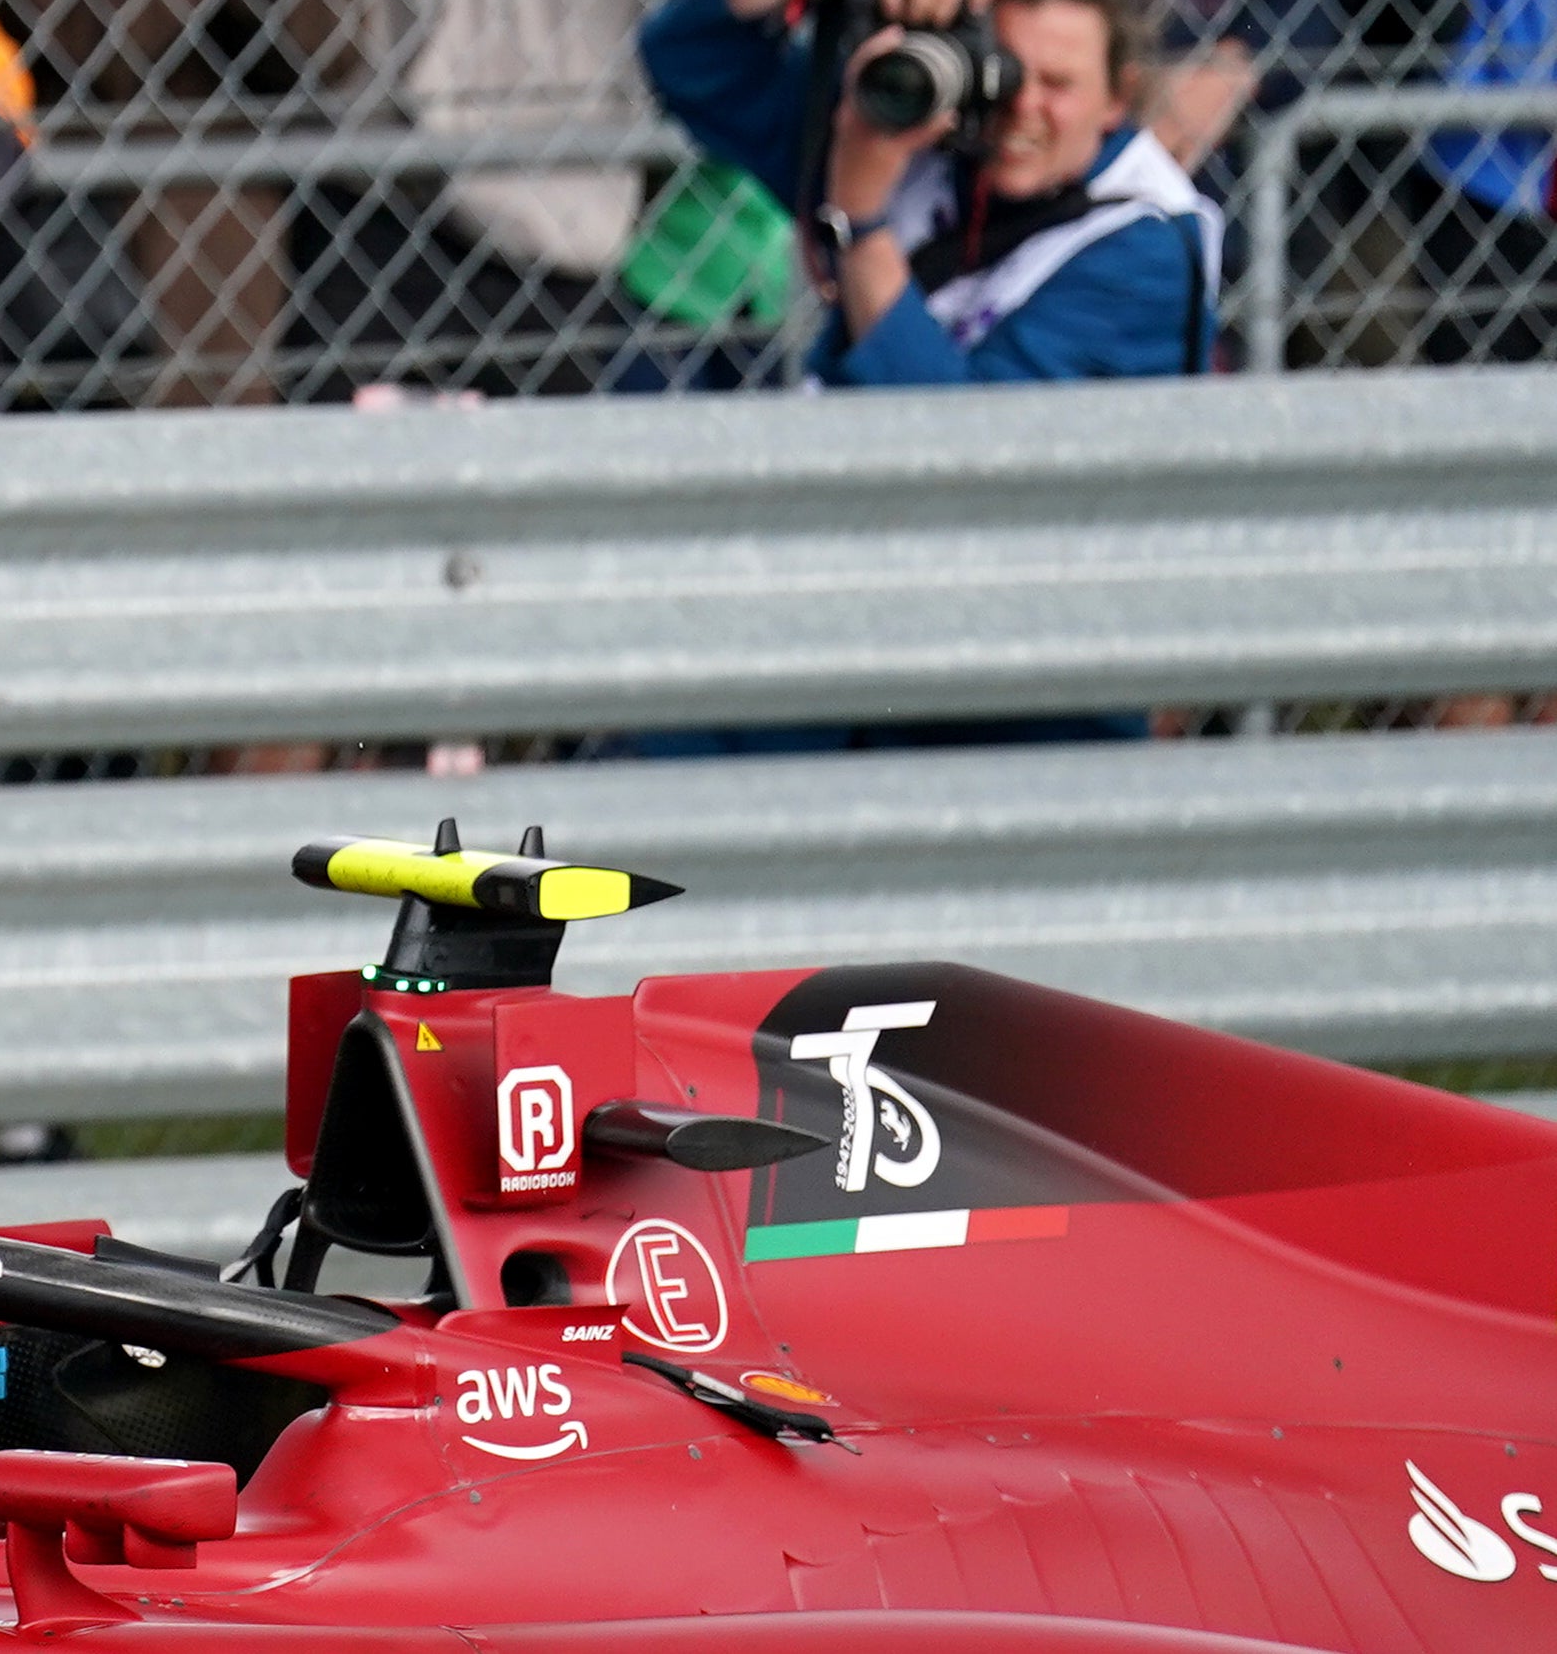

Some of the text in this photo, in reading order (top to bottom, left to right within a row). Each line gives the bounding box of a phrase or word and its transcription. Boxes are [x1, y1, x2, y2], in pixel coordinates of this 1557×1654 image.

[500, 1171, 576, 1193] RADIOBOOK
[634, 1233, 712, 1343] E
[561, 1325, 616, 1342] SAINZ
[456, 1364, 572, 1424] aws
